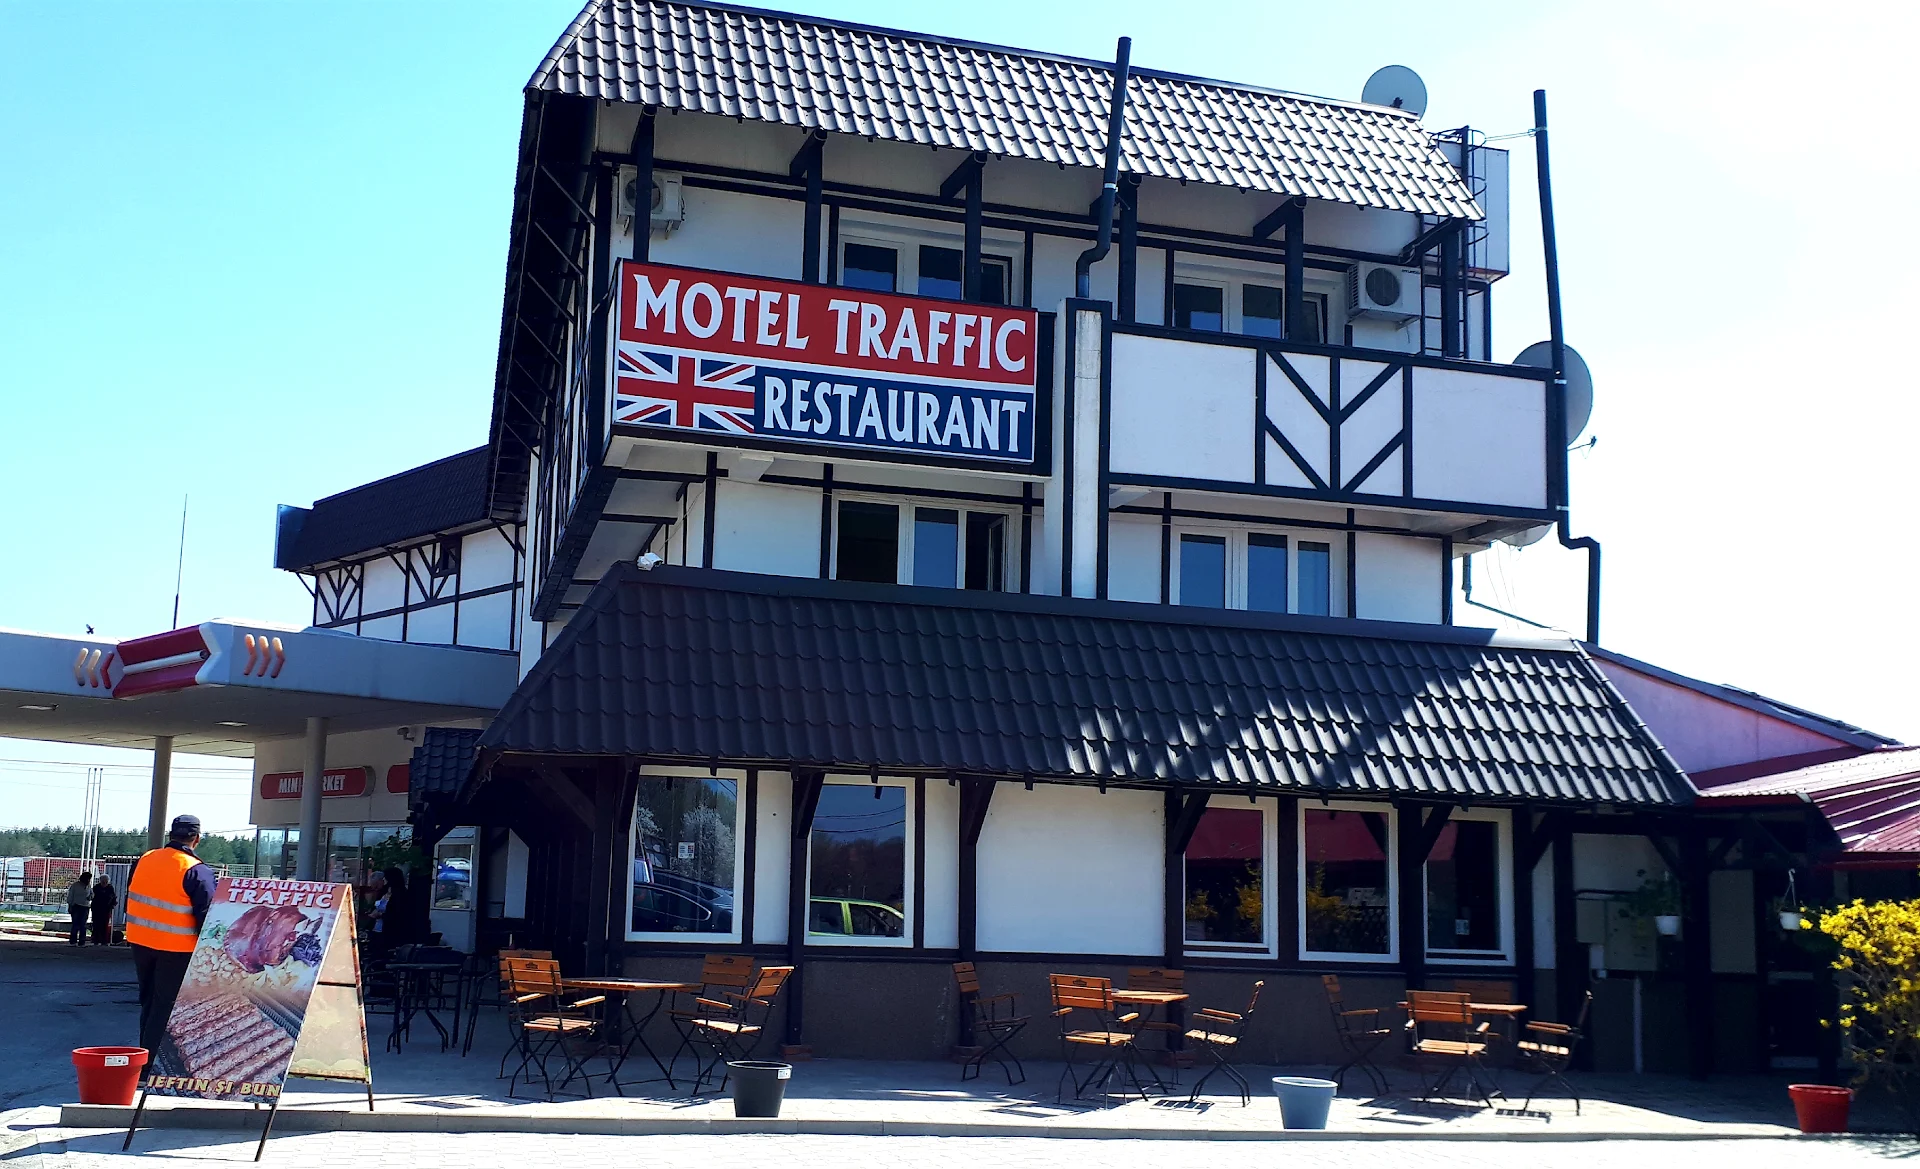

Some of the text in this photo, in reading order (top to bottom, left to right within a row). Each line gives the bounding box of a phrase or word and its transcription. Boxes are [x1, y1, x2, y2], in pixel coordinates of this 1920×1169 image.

[633, 273, 1027, 373] MOTEL TRAFFIC
[763, 375, 1028, 453] RESTAURANT
[230, 878, 336, 893] RESTAURANT
[228, 888, 333, 908] TRAFFIC
[240, 1082, 281, 1098] BUN
